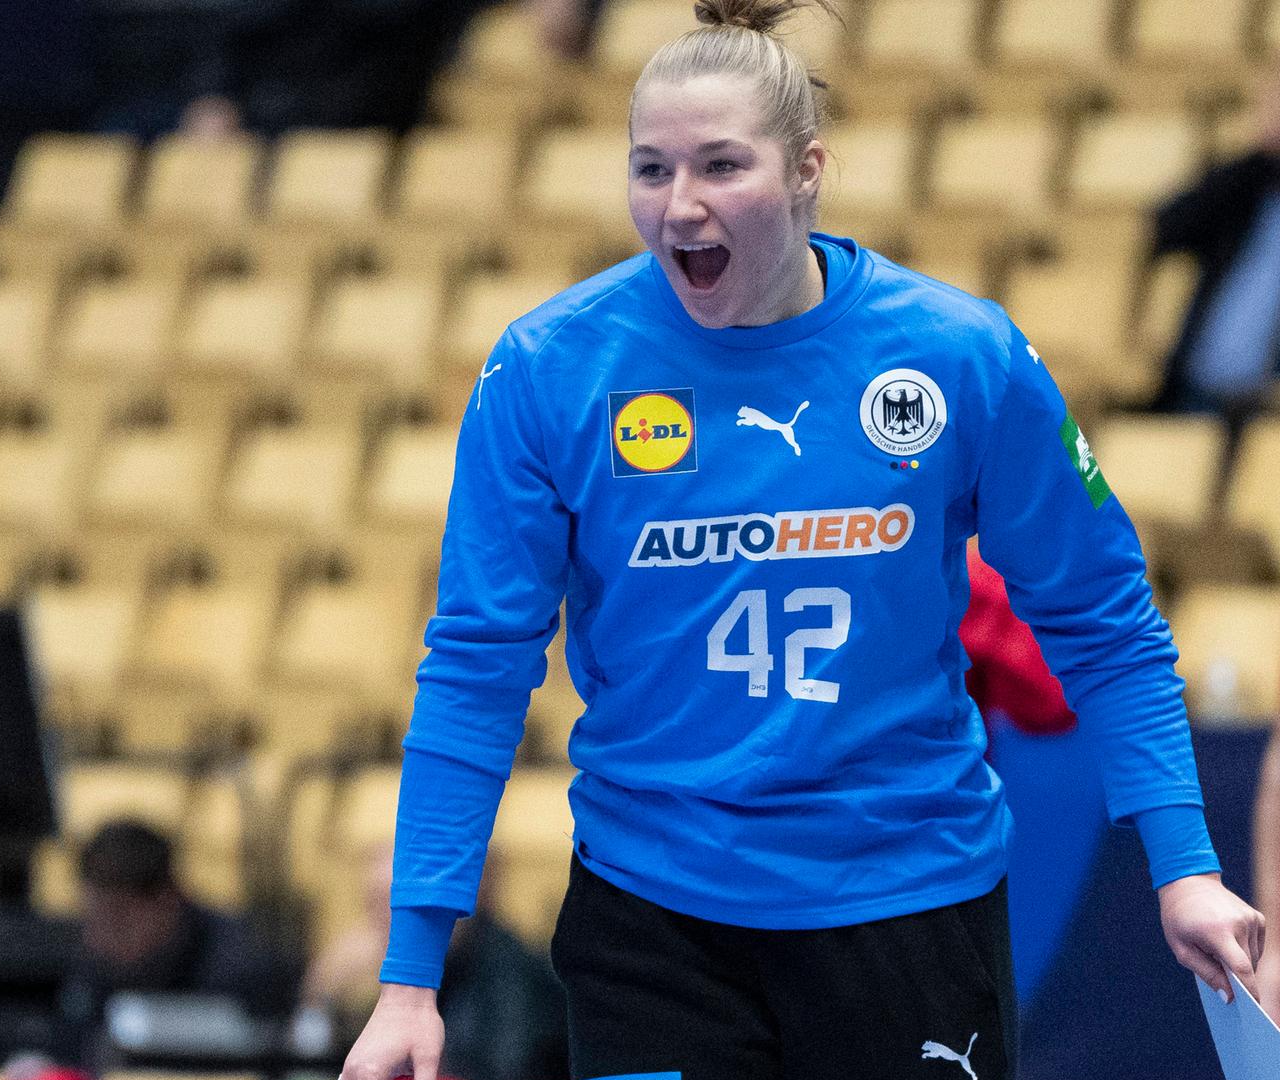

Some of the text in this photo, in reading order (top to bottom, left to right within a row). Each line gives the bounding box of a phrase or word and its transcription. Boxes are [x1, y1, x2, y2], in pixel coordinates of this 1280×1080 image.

[866, 421, 943, 452] DEUTSCHER HANDBALLBUND
[637, 510, 909, 561] AUTOHERO
[707, 587, 852, 703] 42
